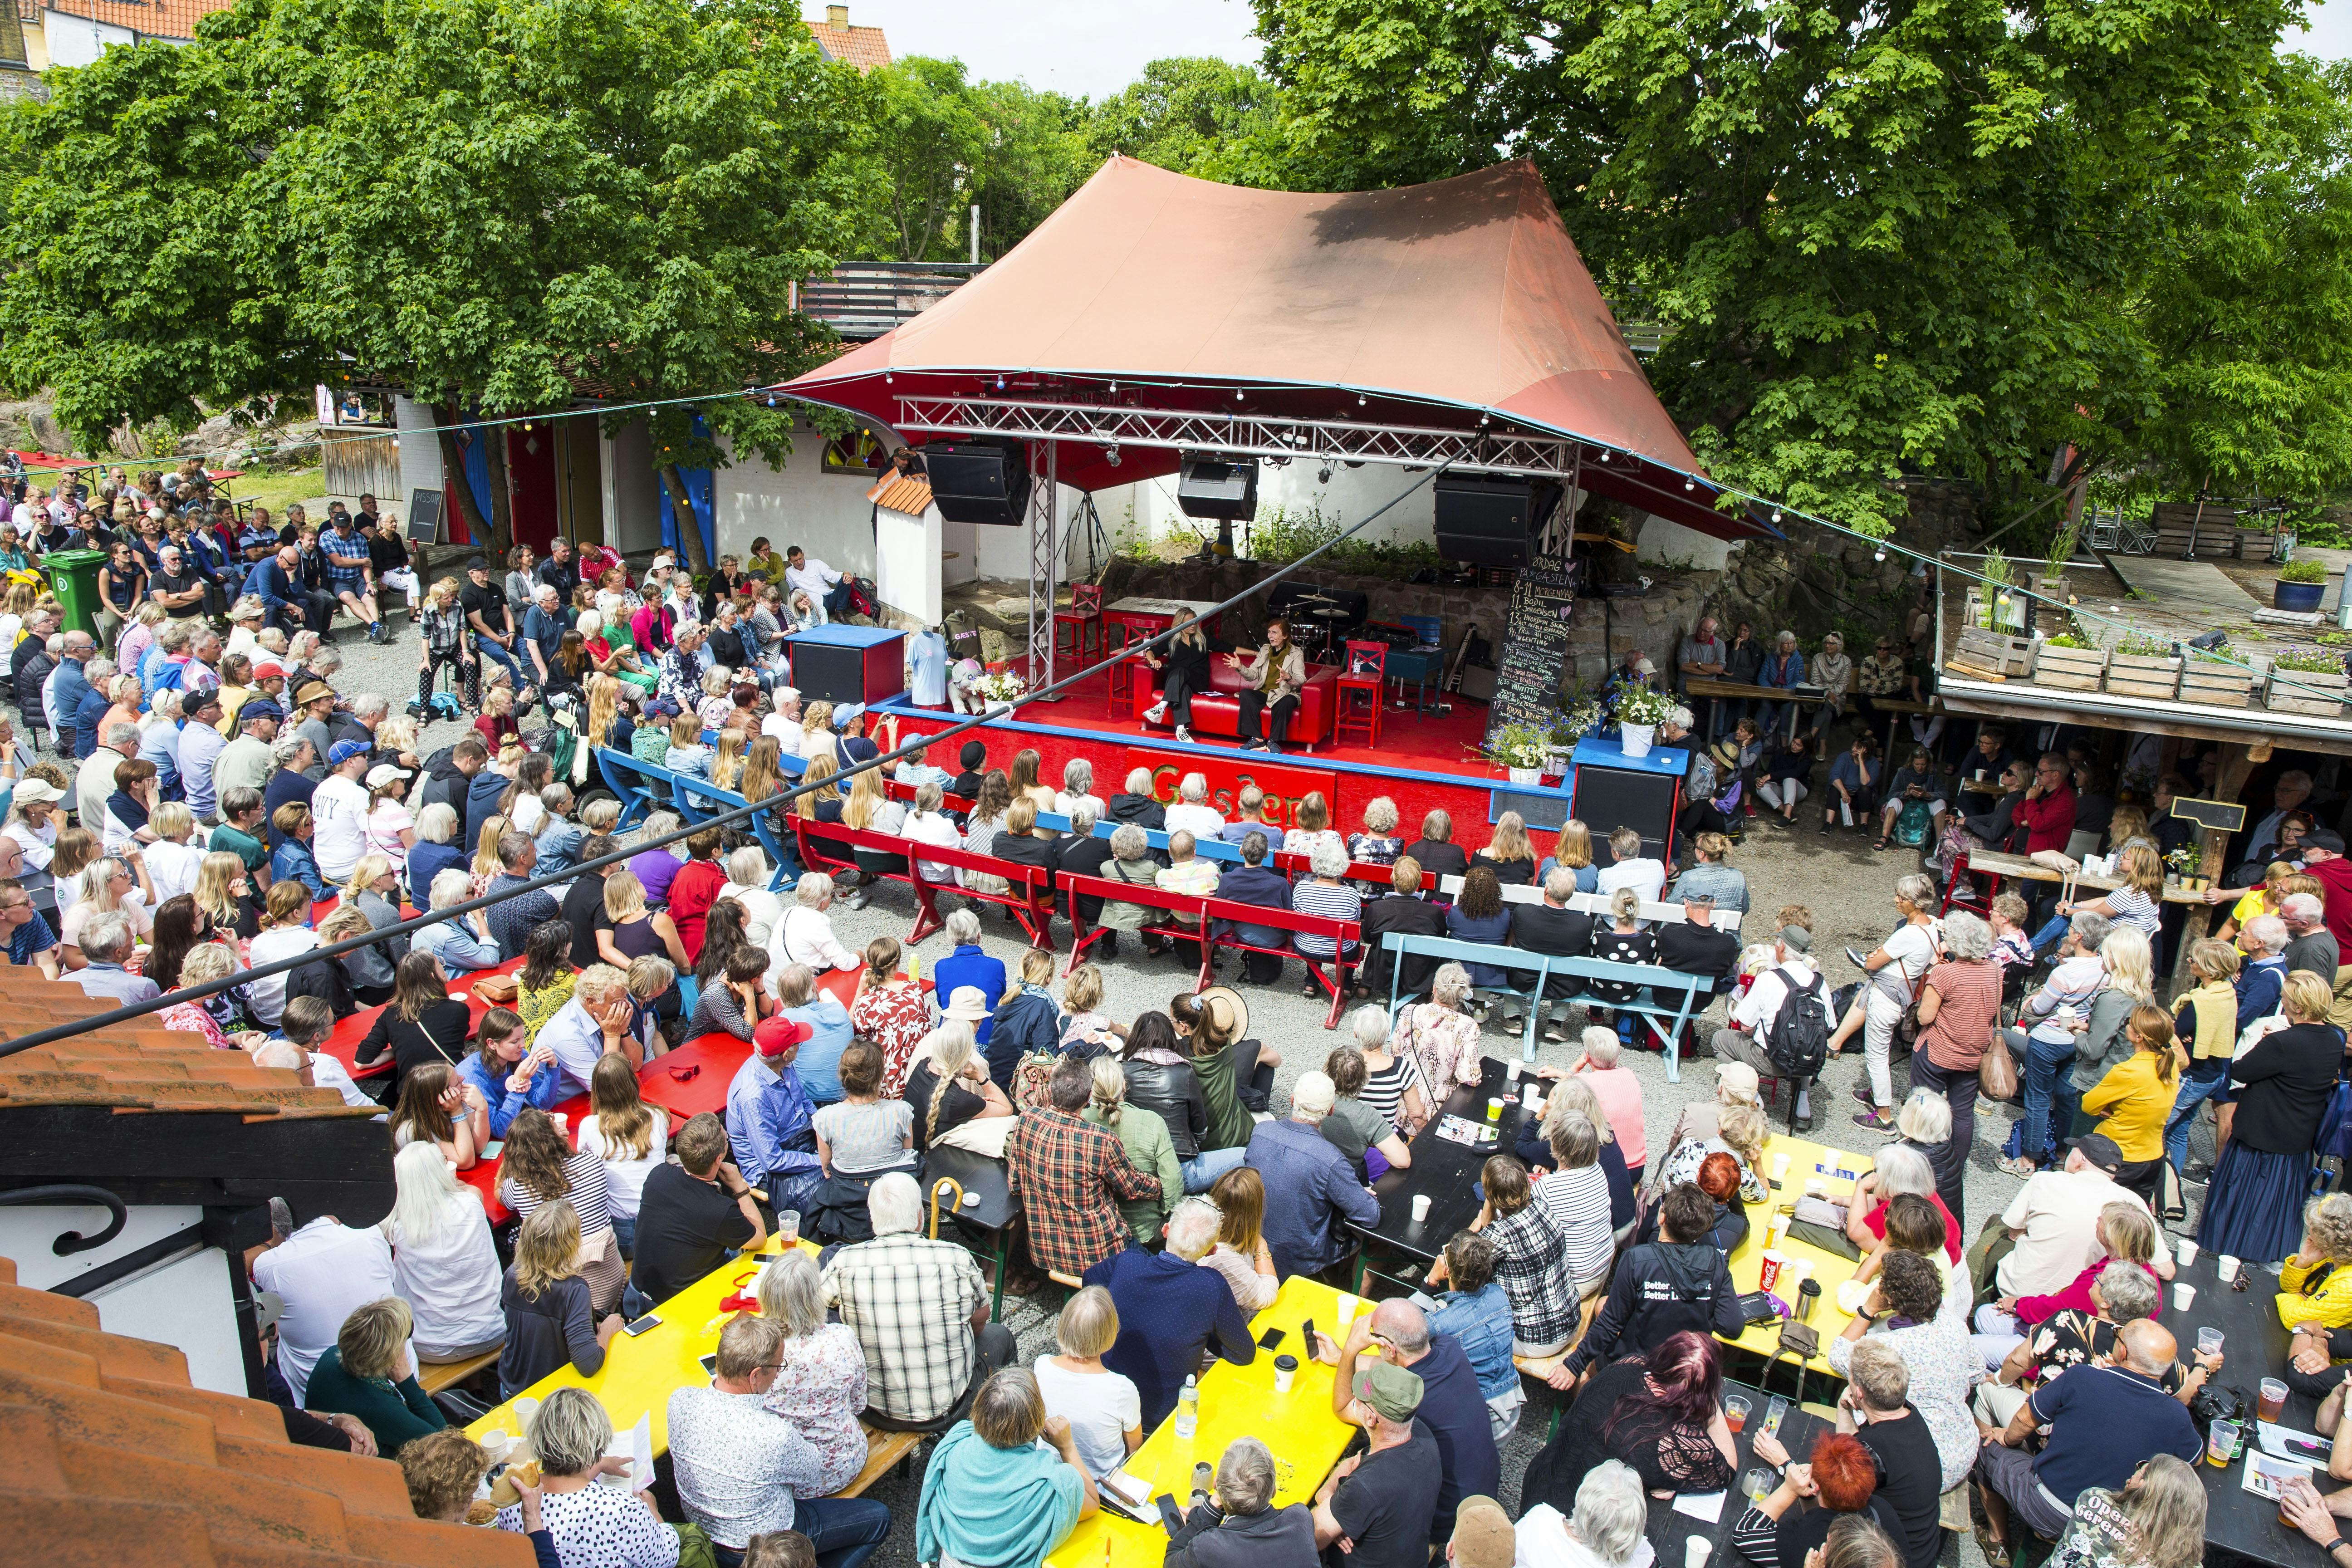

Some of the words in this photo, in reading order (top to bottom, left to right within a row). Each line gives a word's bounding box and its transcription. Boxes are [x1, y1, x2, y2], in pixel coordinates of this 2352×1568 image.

[416, 492, 441, 505] PISSOIR
[1536, 572, 1573, 588] GÆSTEN
[1514, 580, 1532, 597] 8-11
[1535, 586, 1574, 599] MORGENMAD
[1524, 597, 1547, 608] BODIL
[1522, 606, 1558, 618] JØRGENSEN
[1524, 614, 1548, 626] HVORDAN
[1535, 646, 1551, 654] TOBIAS
[1503, 658, 1528, 668] CABARET
[1529, 659, 1548, 669] LARSEN
[1545, 659, 1563, 669] SHOW
[1501, 671, 1518, 681] NICLAS
[1519, 676, 1546, 689] BENDIXEN
[1511, 682, 1540, 696] VANVITTIG
[1496, 692, 1520, 706] KLARLUND
[1523, 700, 1537, 709] PETER
[1500, 688, 1515, 698] BENTE
[1519, 693, 1538, 703] SUND
[1506, 704, 1522, 717] KAYA
[1644, 1281, 1670, 1290] Better
[1644, 1290, 1670, 1300] Better
